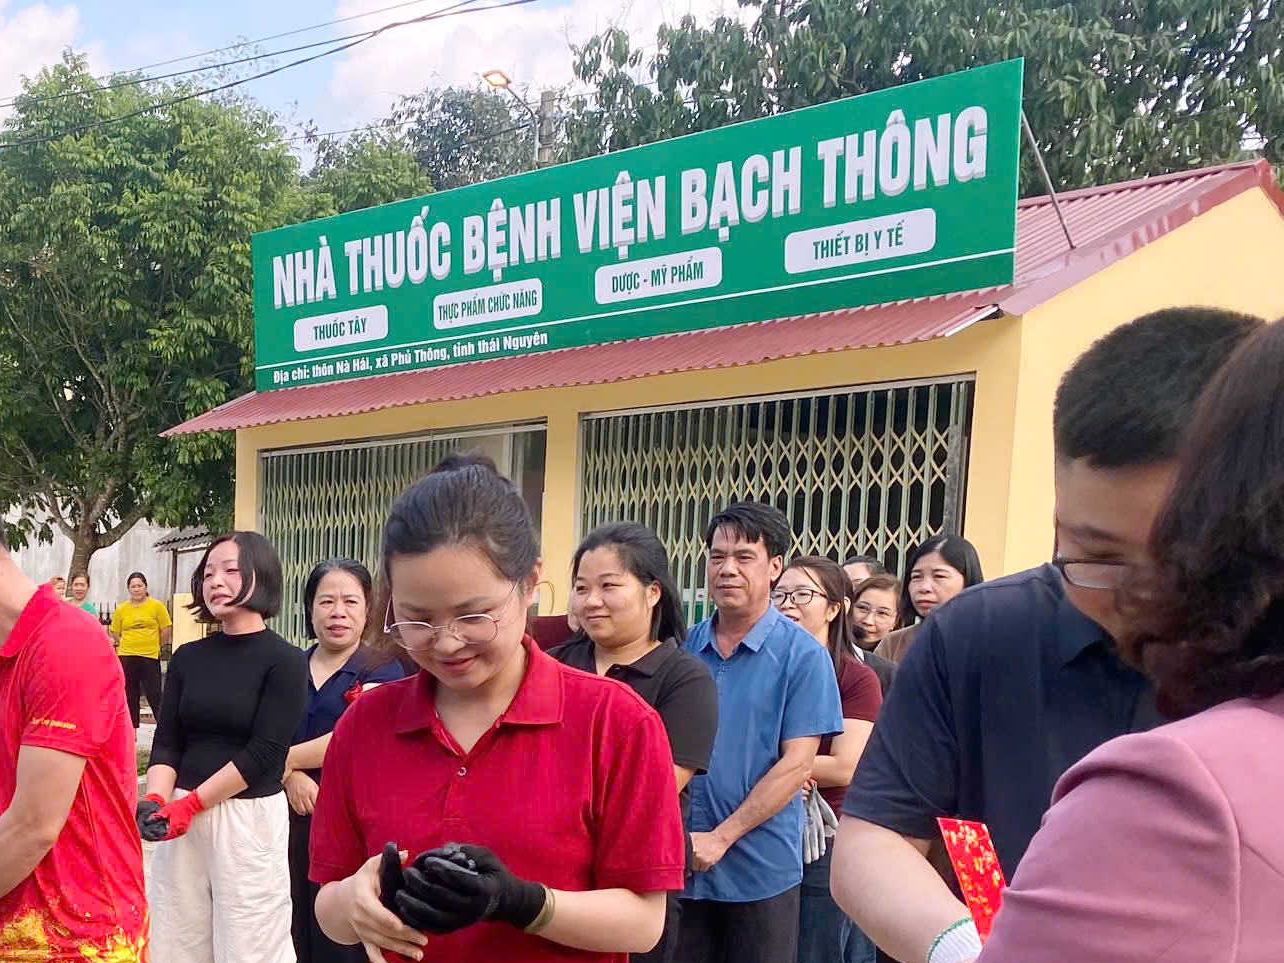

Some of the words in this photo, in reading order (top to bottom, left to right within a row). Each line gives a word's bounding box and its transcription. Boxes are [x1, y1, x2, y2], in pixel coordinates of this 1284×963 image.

[273, 235, 337, 309] NHÀ
[344, 205, 451, 295] THUỐC
[463, 197, 562, 282] BỆNH
[573, 170, 666, 260] VIỆN
[680, 146, 802, 242] BẠCH
[817, 105, 988, 208] THÔNG
[813, 230, 851, 260] THIẾT
[855, 233, 869, 256] BỊ
[874, 230, 883, 250] Y
[887, 220, 906, 247] TẾ
[612, 271, 640, 295] DƯỢC
[651, 264, 667, 288] MỸ
[671, 256, 704, 283] PHẨM
[438, 304, 460, 324] THỰC
[513, 289, 538, 309] NĂNG
[313, 317, 346, 341] THUỐC
[348, 315, 367, 335] TÂY
[273, 369, 289, 385] Địa
[312, 363, 334, 378] thôn
[336, 359, 350, 375] Nà
[375, 355, 389, 369] xã
[414, 347, 451, 363] Thông,
[503, 331, 548, 350] Nguyên
